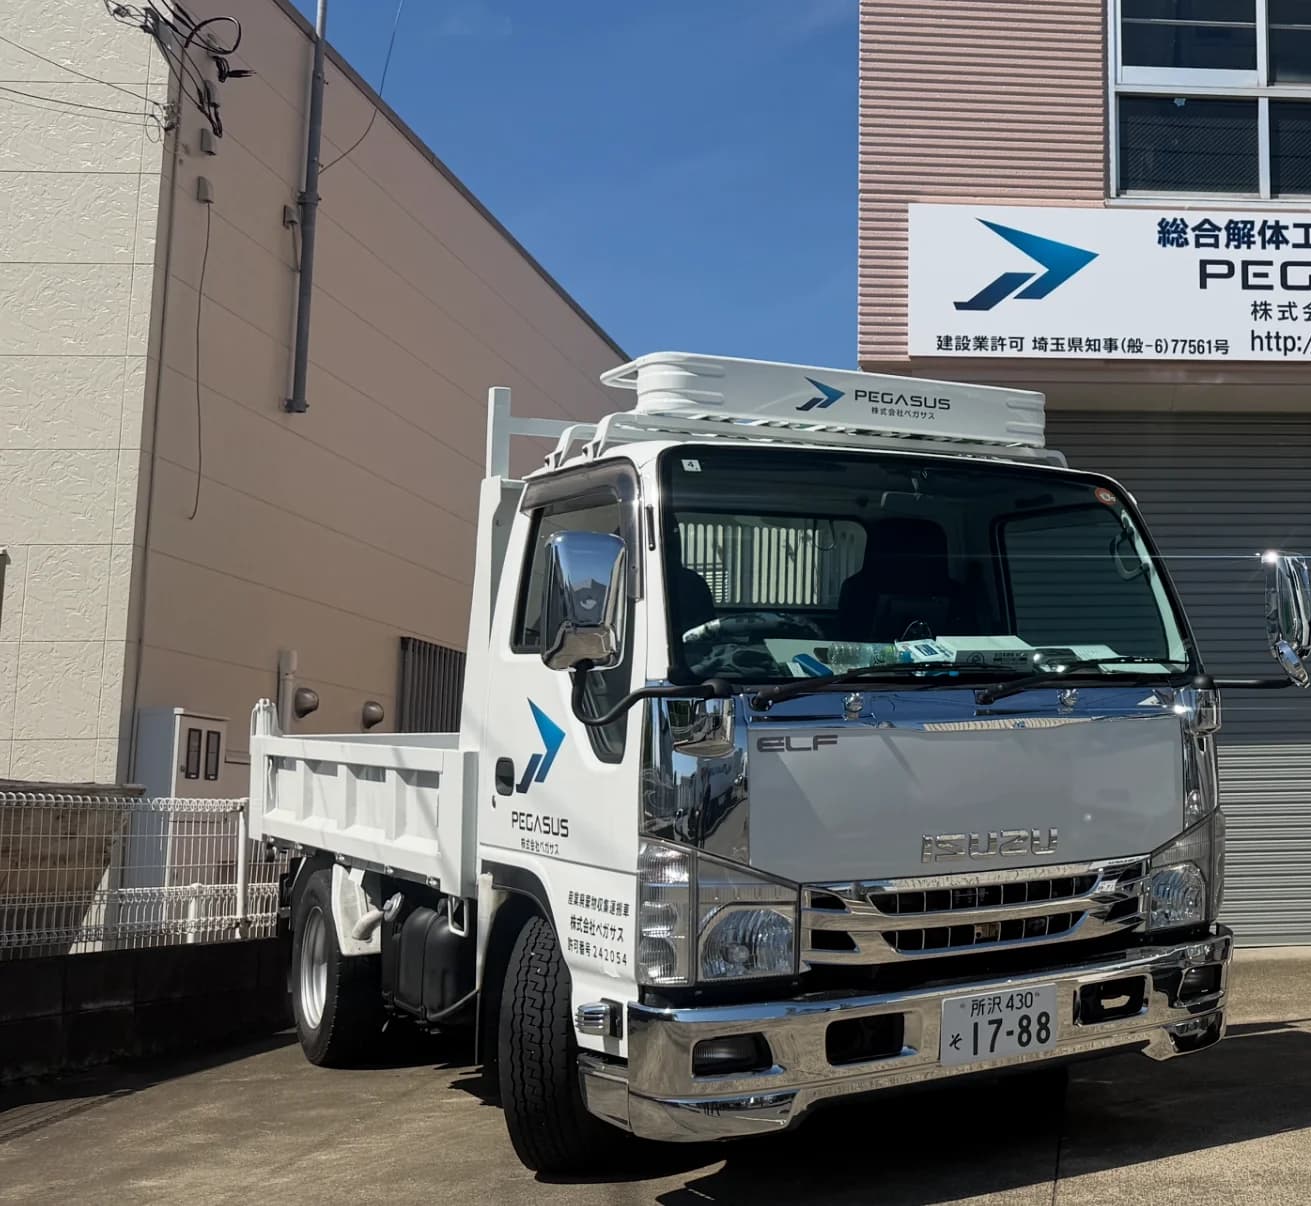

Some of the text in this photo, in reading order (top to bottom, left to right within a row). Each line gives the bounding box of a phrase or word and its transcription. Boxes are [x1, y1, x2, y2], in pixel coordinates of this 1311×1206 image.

[936, 335, 1025, 351] 建設業許可
[854, 389, 951, 411] PEGASUS
[871, 406, 936, 420] 株式会社ペガサス
[756, 734, 839, 753] ELF
[511, 810, 569, 838] PEGASUS
[921, 826, 1059, 864] ISUZU
[570, 914, 625, 943] 株式会社ペガサス
[970, 991, 1034, 1018] 所沢 430
[972, 1010, 1051, 1057] 17-88
